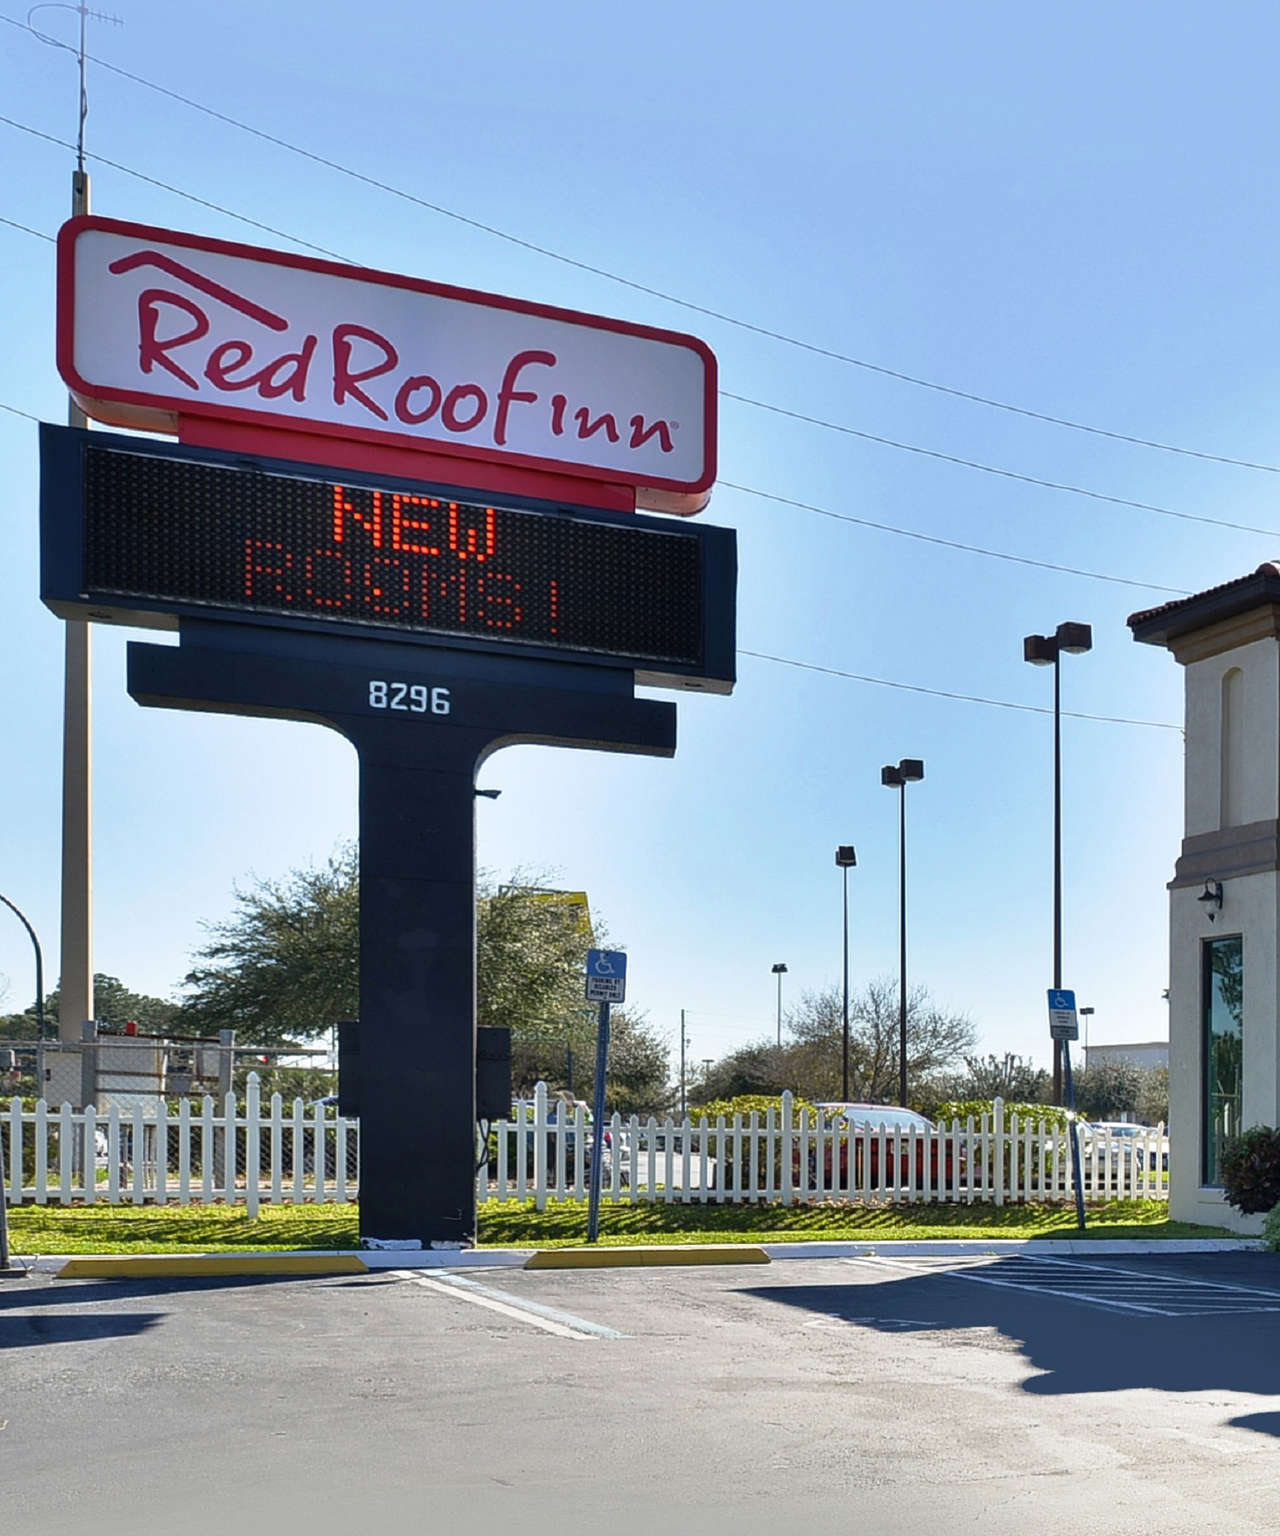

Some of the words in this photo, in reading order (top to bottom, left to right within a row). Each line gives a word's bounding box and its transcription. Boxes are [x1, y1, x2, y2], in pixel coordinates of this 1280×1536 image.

[137, 288, 317, 404] Red
[332, 323, 557, 447] Roof
[333, 485, 495, 562] NEW
[369, 680, 450, 715] 8296
